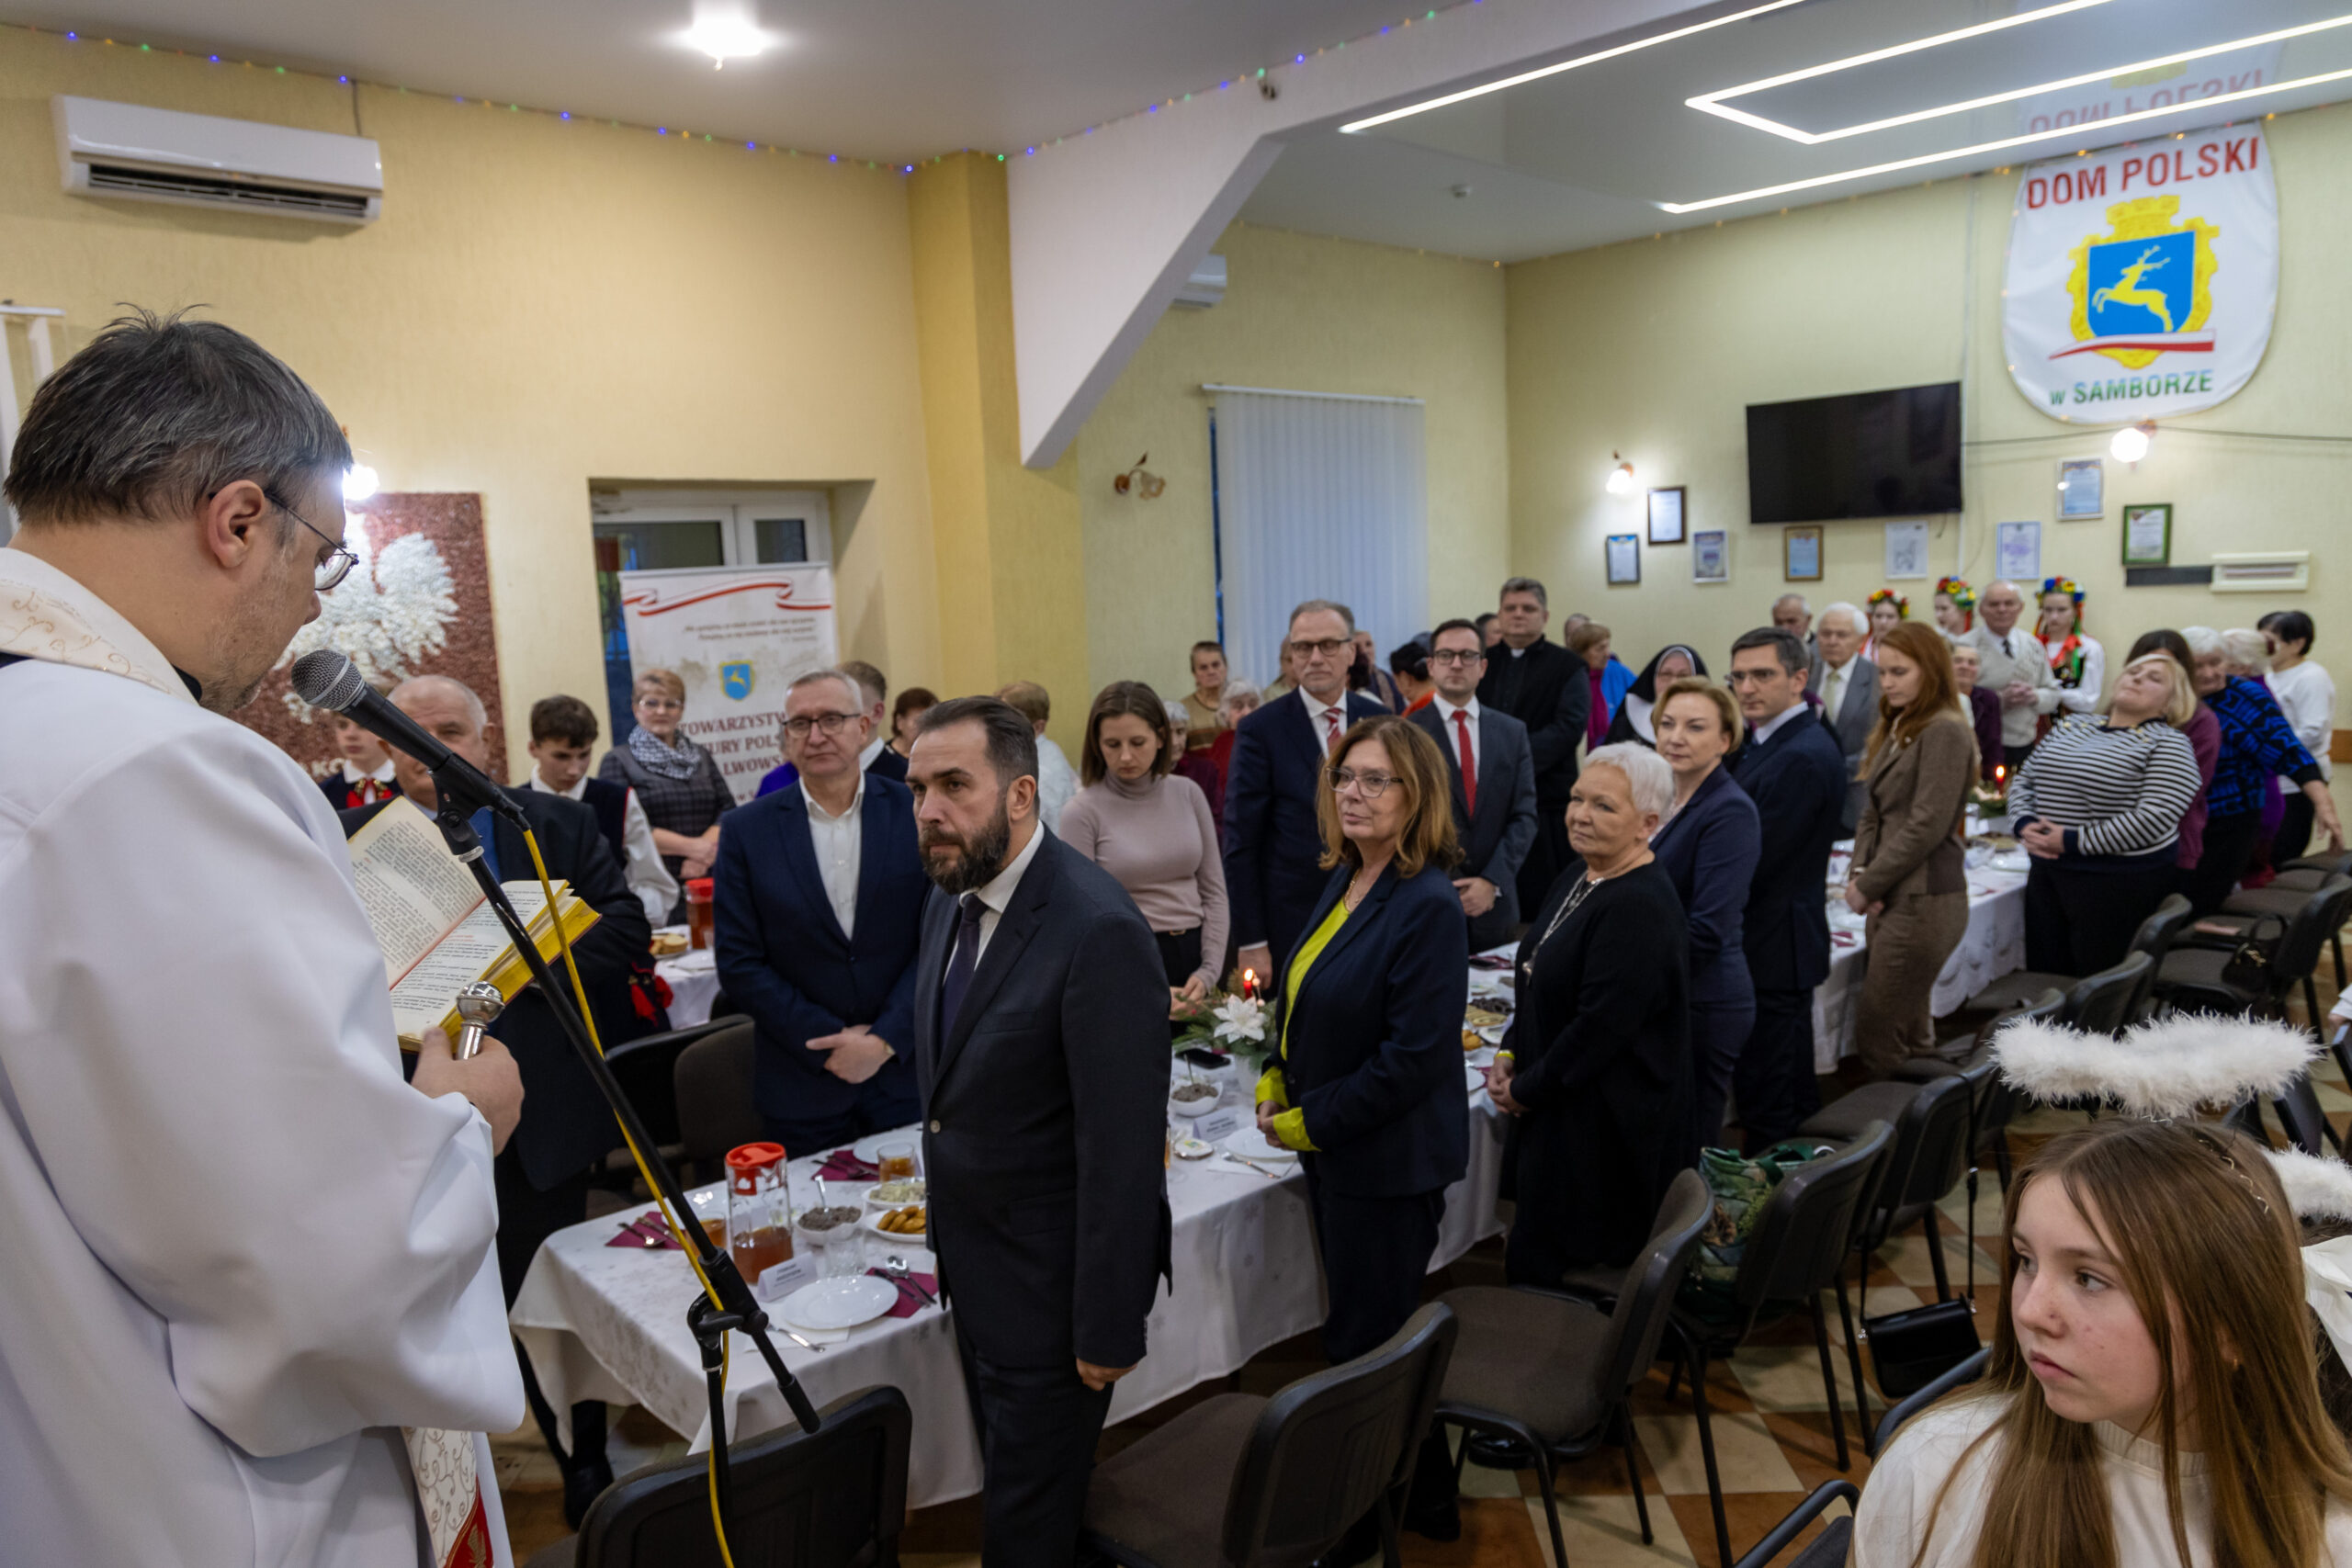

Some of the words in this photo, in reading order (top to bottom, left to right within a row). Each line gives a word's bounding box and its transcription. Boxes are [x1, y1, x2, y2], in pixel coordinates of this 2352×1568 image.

[2027, 165, 2107, 209] DOM
[2121, 136, 2259, 191] POLSKI
[2074, 370, 2214, 404] SAMBORZE
[677, 711, 786, 736] TOWARZYSTW
[745, 735, 780, 750] POLS
[723, 755, 781, 775] LWOWS
